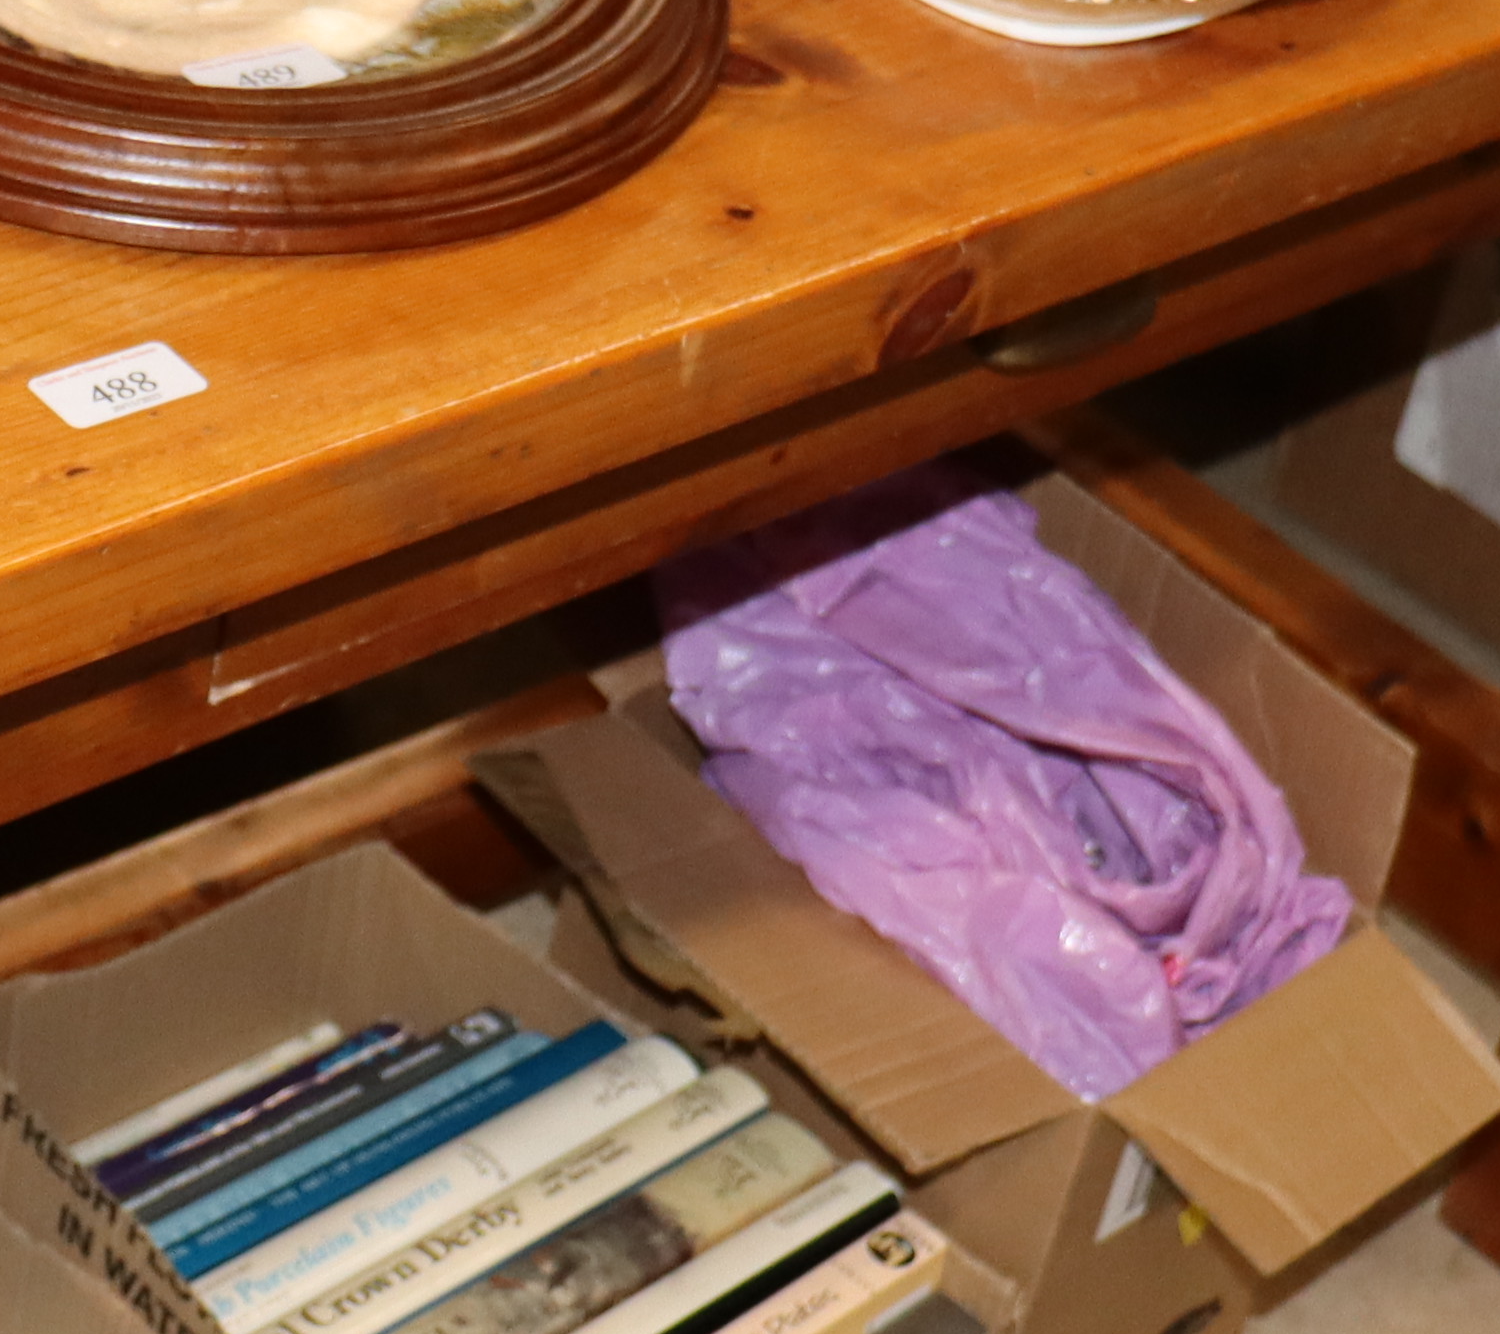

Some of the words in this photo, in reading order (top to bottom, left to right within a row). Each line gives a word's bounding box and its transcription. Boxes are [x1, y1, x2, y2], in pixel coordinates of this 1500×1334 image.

[238, 64, 297, 87] 489
[91, 371, 158, 404] 488
[57, 1202, 95, 1259] IN
[301, 1255, 417, 1330] Crown
[416, 1194, 525, 1267] Derby
